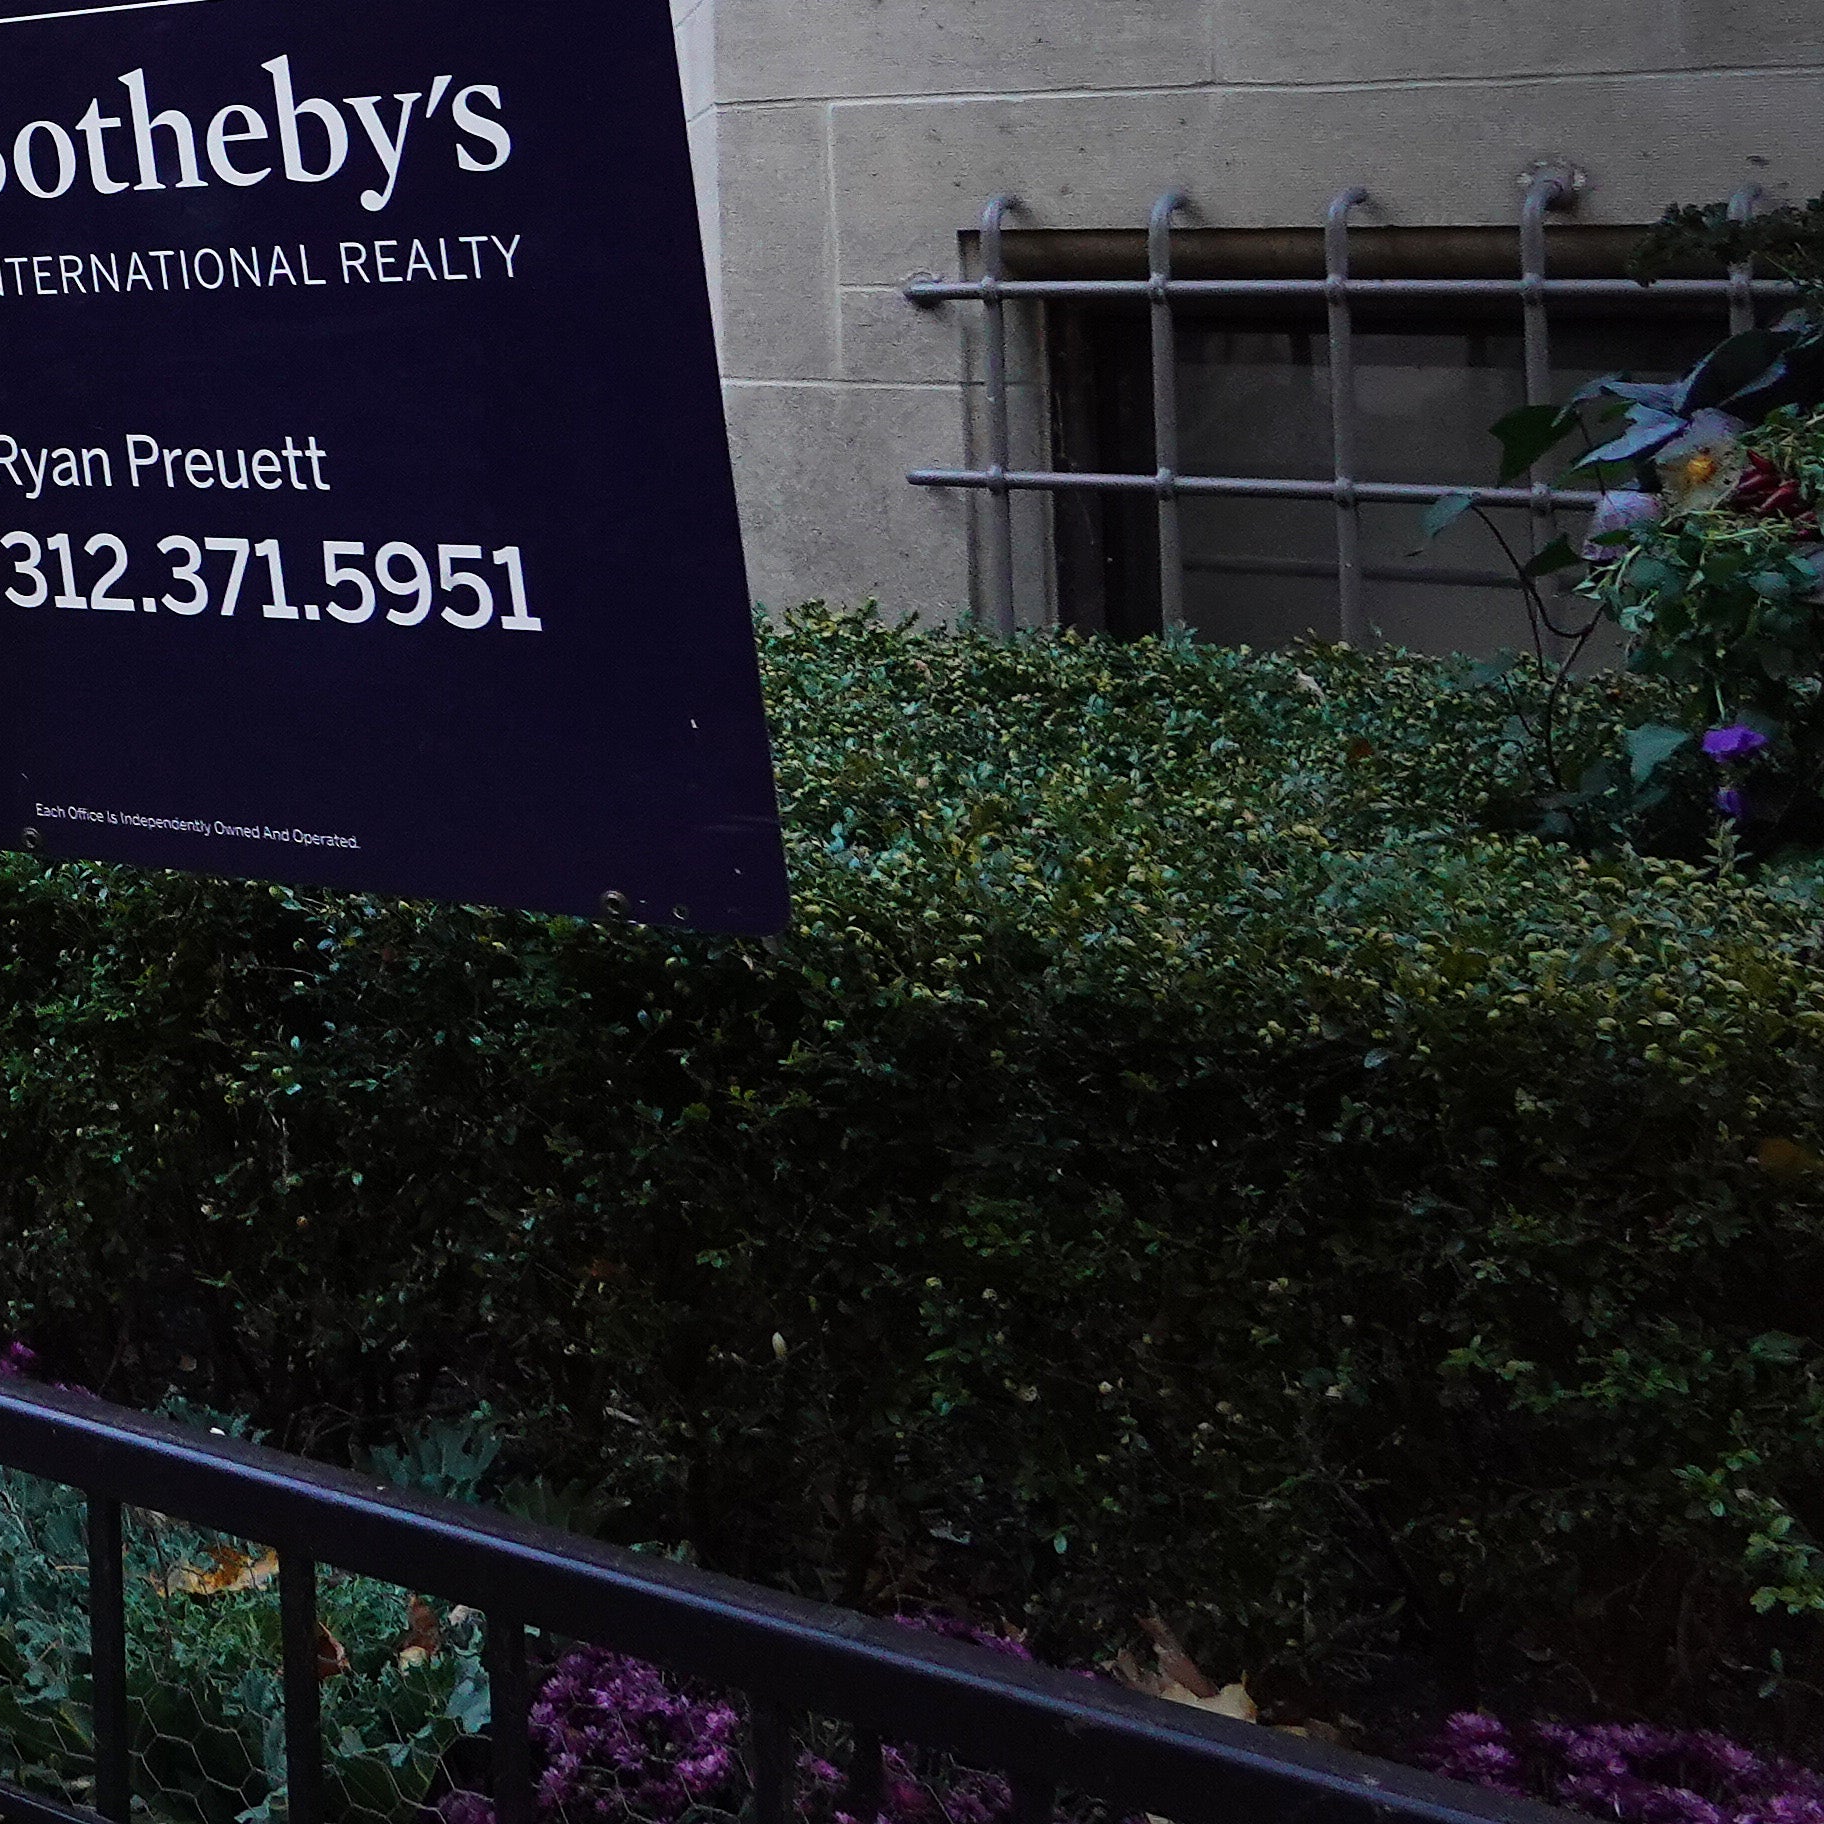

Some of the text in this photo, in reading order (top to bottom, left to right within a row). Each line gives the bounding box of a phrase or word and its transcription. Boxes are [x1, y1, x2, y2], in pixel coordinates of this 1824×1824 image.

[339, 234, 521, 284] REALTY
[125, 433, 331, 491] Preuett
[0, 530, 543, 632] 312.371.5951
[35, 802, 362, 849] Each Office Is Independently Owned And Operated.
